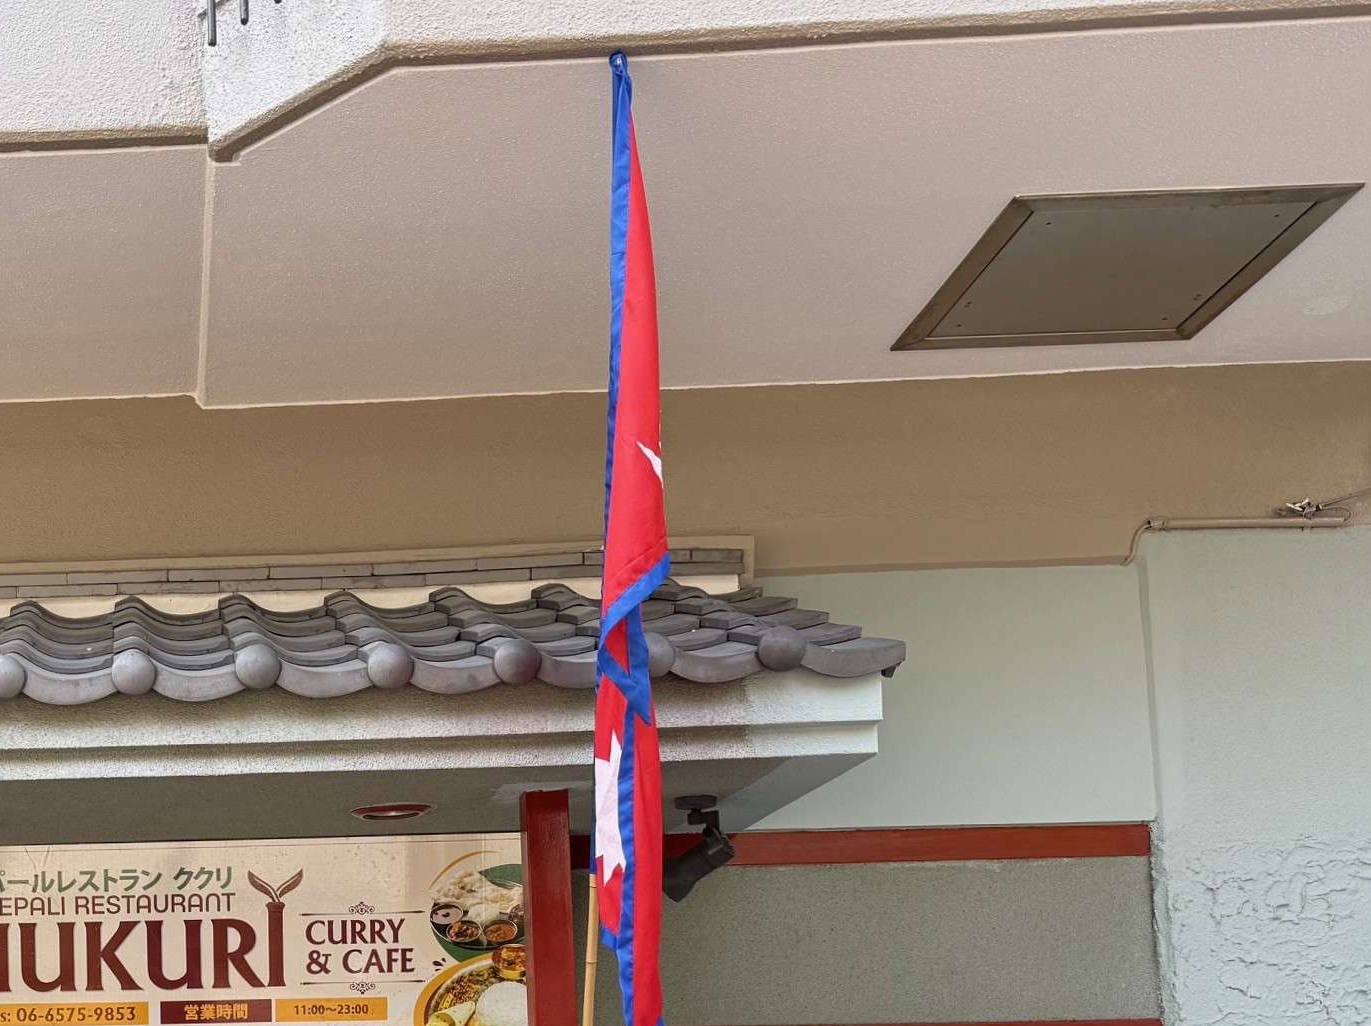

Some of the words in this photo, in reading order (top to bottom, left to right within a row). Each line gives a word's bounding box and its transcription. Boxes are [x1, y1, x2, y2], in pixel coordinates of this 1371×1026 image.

[173, 866, 232, 891] ククリ
[75, 893, 236, 916] RESTAURANT
[305, 917, 406, 945] CURRY
[306, 949, 332, 975] &
[341, 947, 415, 974] CAFE
[16, 1006, 136, 1023] 06-6575-9853
[184, 1003, 248, 1021] 営業時間
